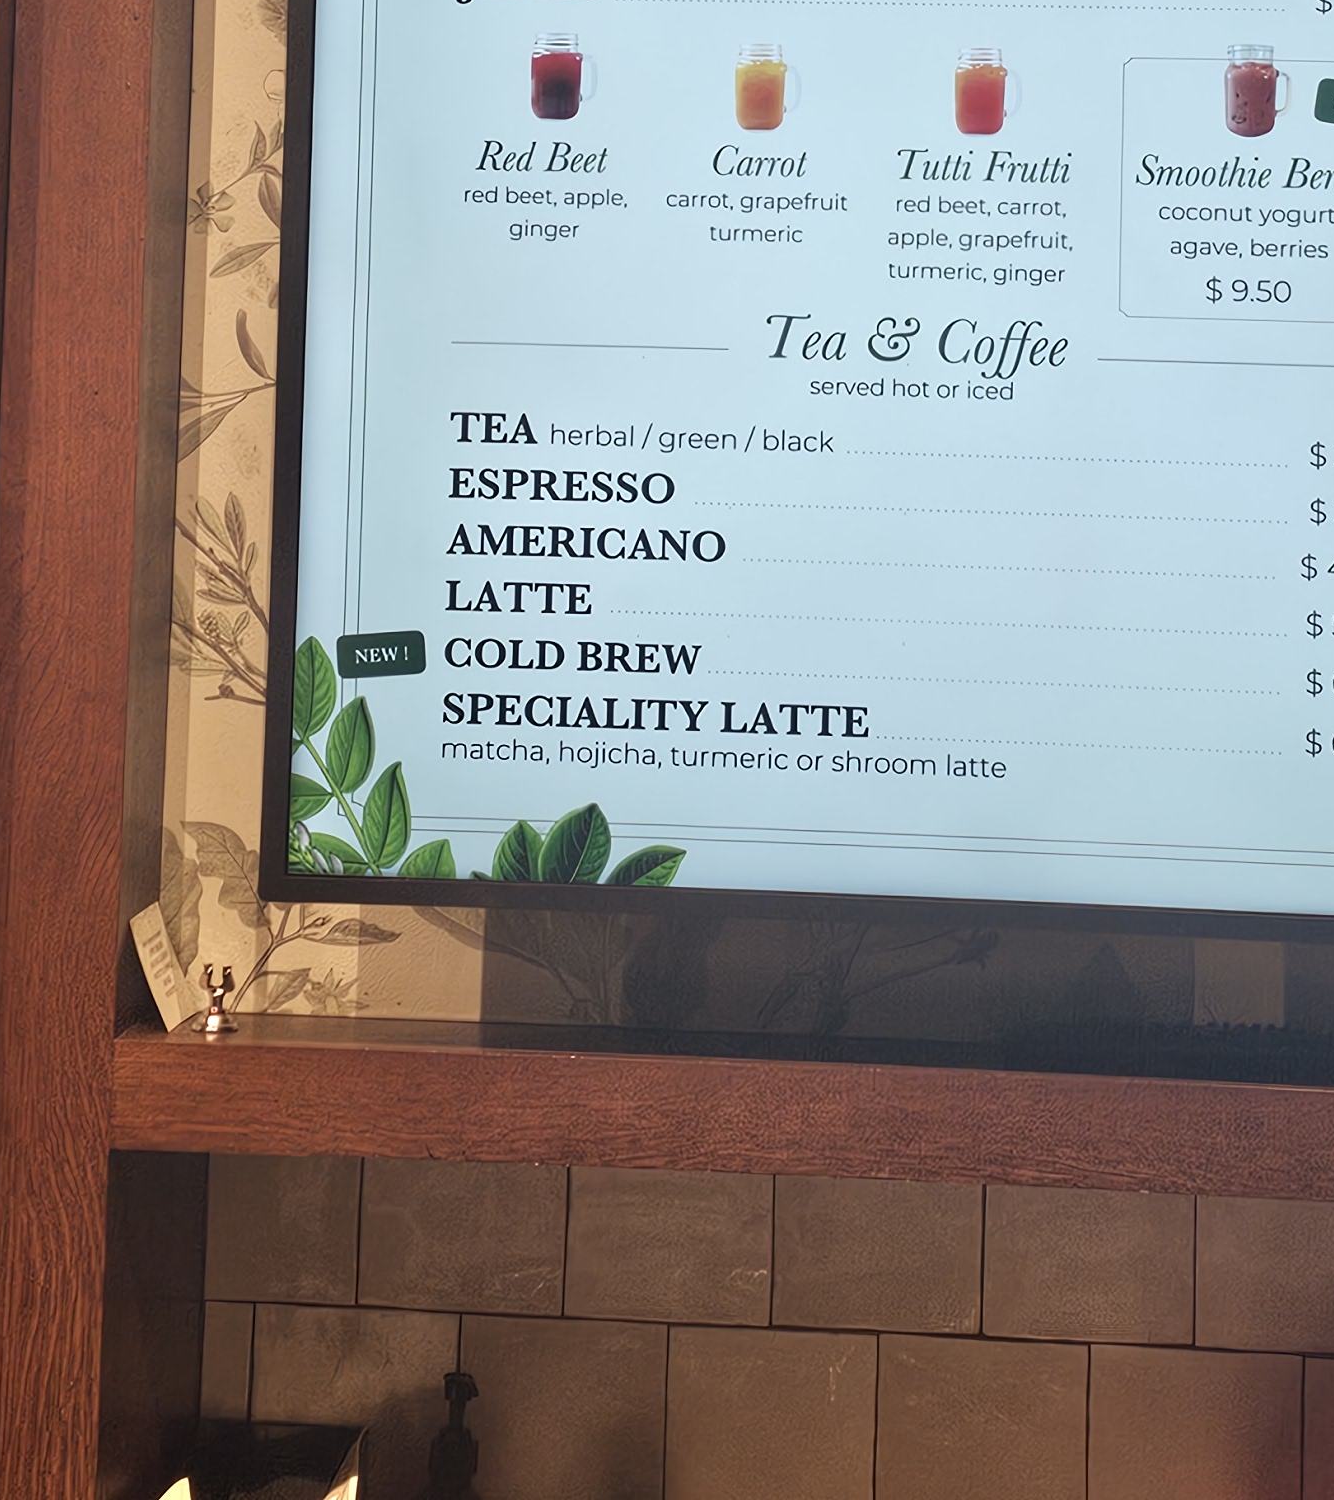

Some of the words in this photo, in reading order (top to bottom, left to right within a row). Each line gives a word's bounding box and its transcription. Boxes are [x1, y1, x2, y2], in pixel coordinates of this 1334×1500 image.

[475, 139, 537, 172] Red
[543, 140, 608, 174] Beet
[712, 143, 807, 178] Carrot
[897, 147, 974, 182] Tutti
[982, 149, 1073, 184] Frutti
[1135, 152, 1272, 189] Smoothie
[766, 312, 847, 361] Tea
[867, 315, 921, 362] &
[938, 317, 1069, 380] Coffee
[809, 376, 885, 397] served
[892, 377, 930, 399] hot
[936, 383, 960, 399] or
[967, 380, 1014, 401] iced
[450, 410, 539, 445] TEA
[550, 422, 634, 447] herbal
[640, 421, 654, 450] /
[658, 430, 737, 454] green
[744, 424, 756, 453] /
[763, 427, 834, 453] black
[355, 646, 398, 664] NEW
[444, 636, 565, 670] COLD
[576, 640, 703, 676] BREW
[442, 691, 710, 732] SPECIALITY
[719, 700, 870, 738] LATTE
[441, 737, 550, 765] matcha,
[559, 738, 662, 770] hojicha,
[670, 745, 789, 771] turmeric
[796, 753, 824, 772] or
[831, 748, 936, 776] shroom
[946, 752, 1007, 779] latte
